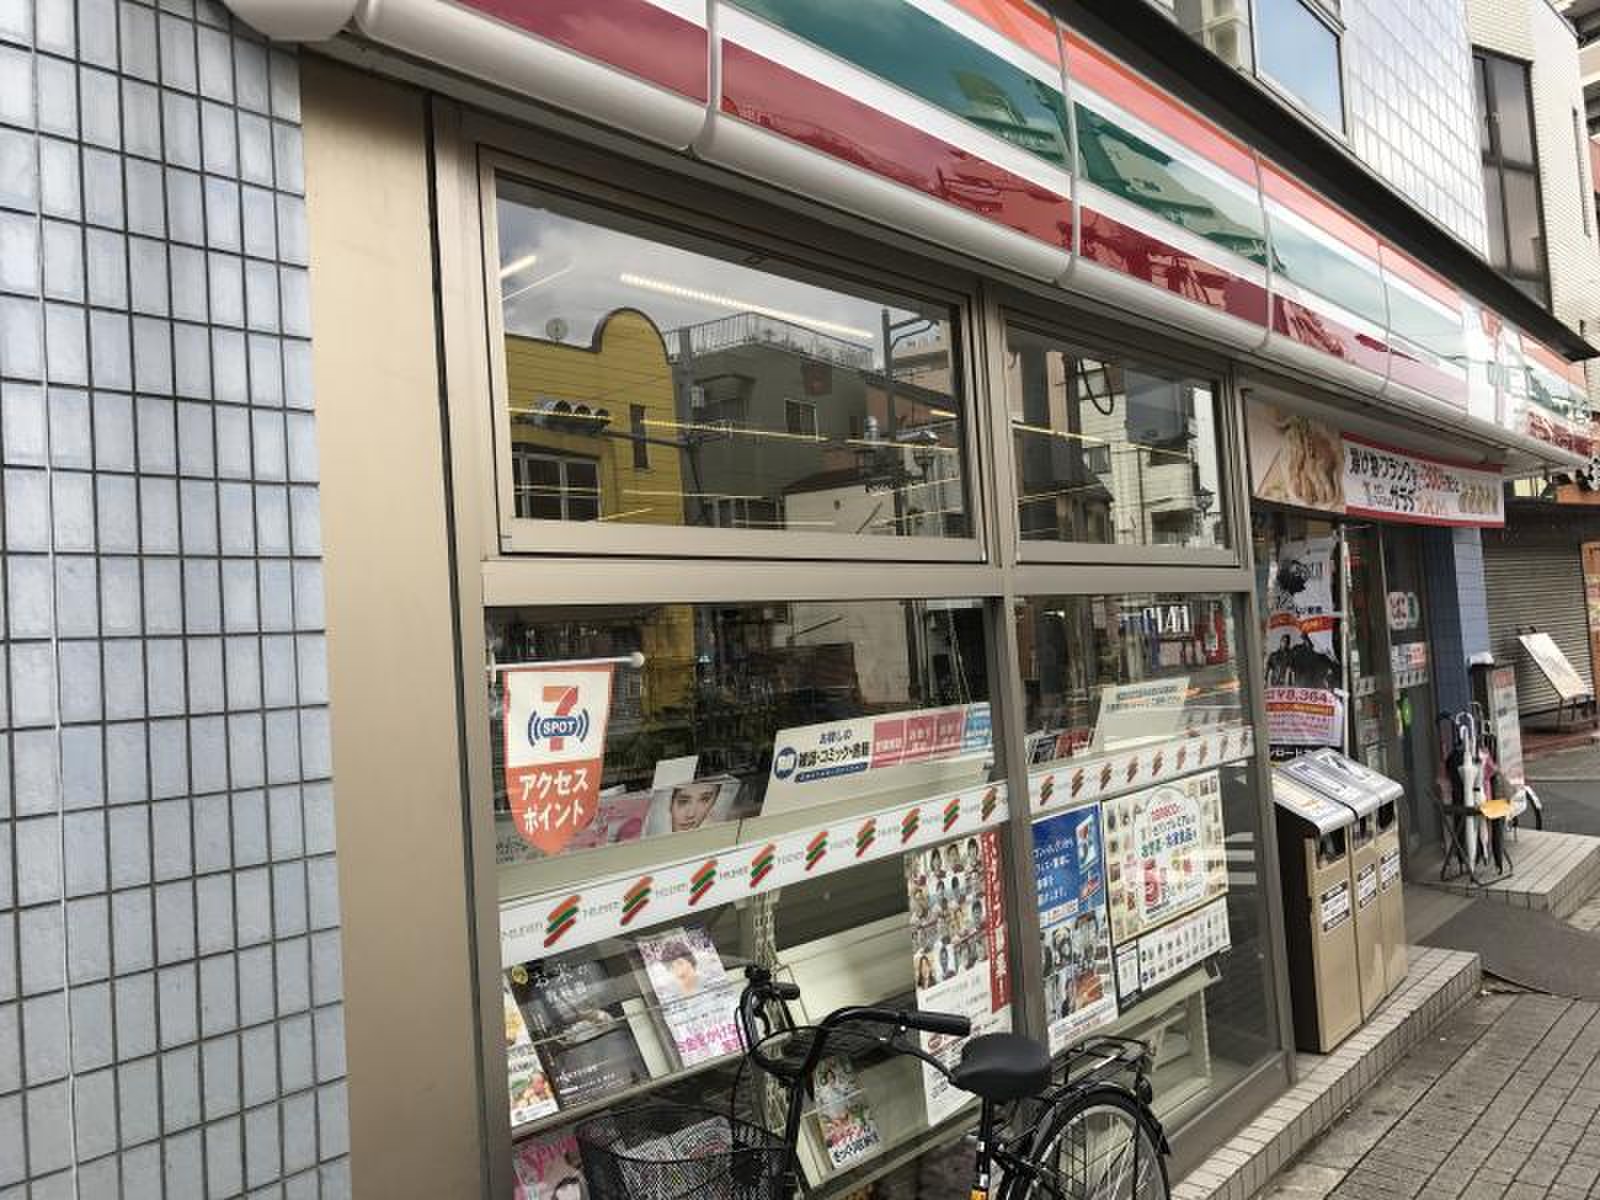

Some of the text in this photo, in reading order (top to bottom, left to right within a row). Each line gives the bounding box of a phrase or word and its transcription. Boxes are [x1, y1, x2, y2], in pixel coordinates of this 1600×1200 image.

[542, 721, 576, 735] SPOT
[519, 767, 590, 801] アクセス
[523, 799, 585, 834] ポイント
